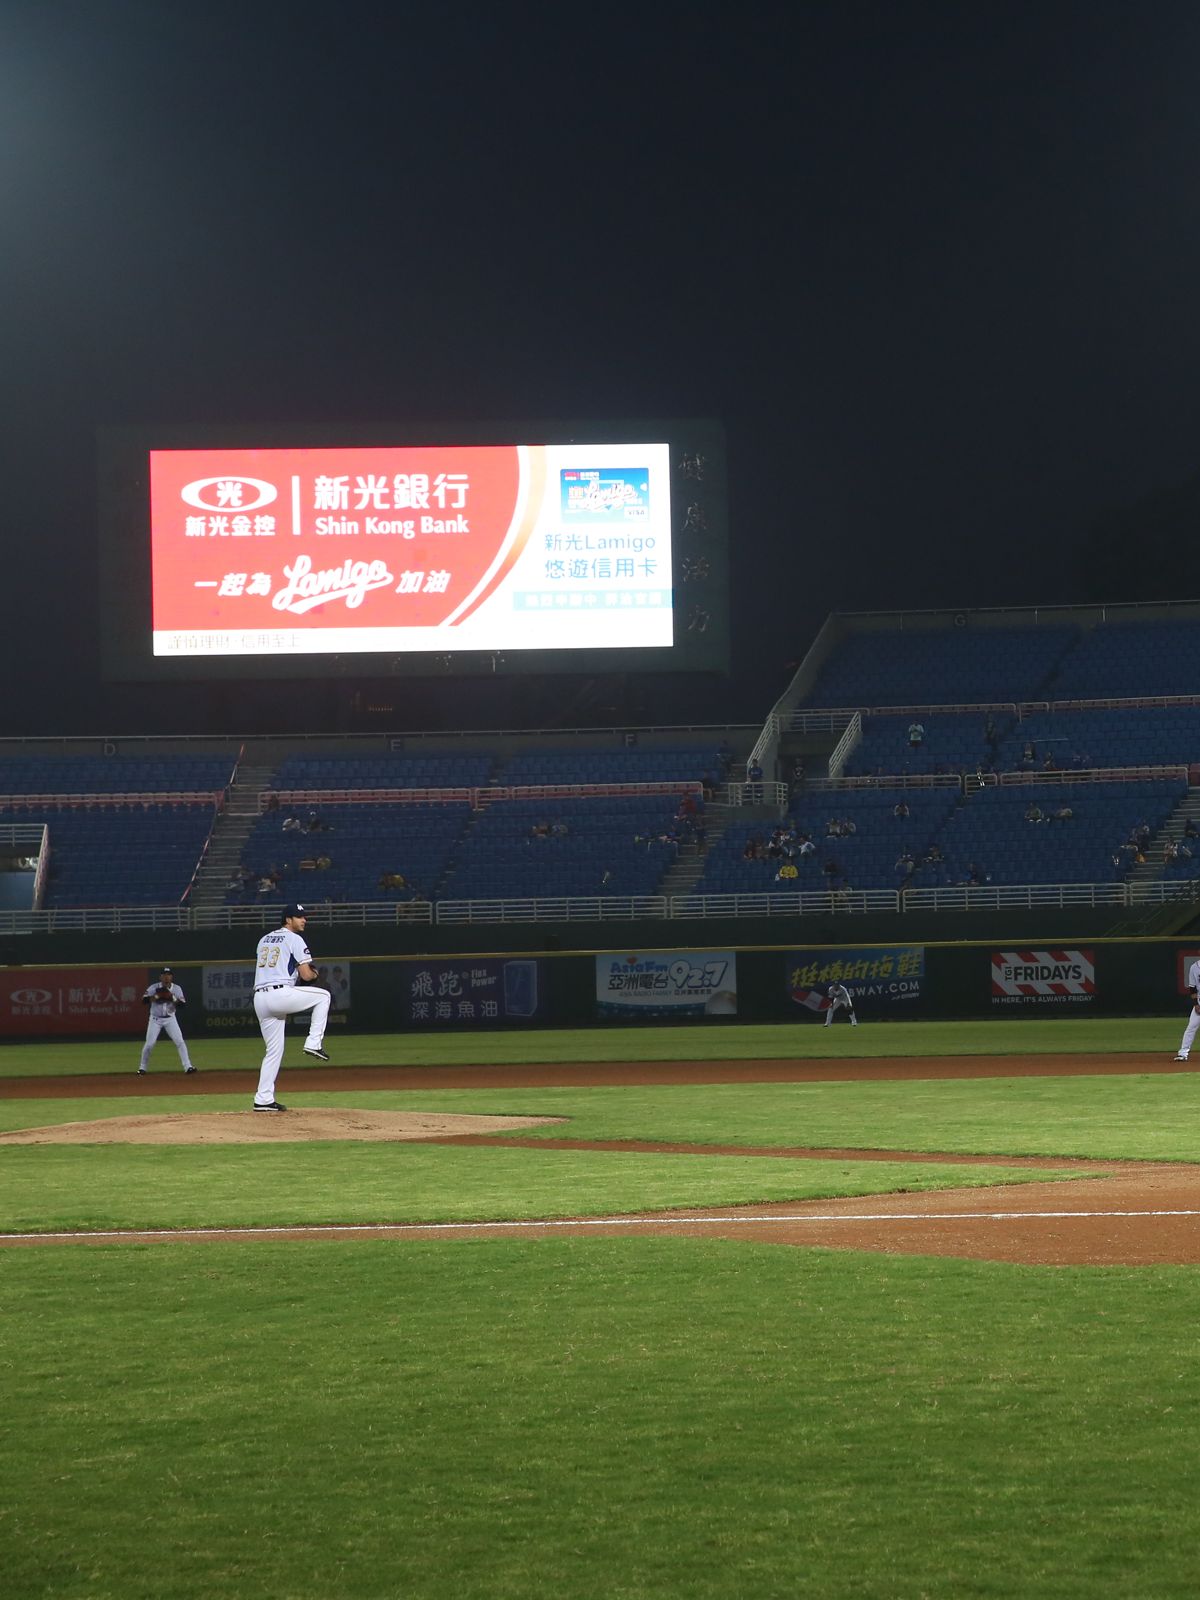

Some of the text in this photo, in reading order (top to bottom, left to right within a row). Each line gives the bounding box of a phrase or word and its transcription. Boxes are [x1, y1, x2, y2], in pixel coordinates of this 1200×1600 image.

[216, 481, 243, 507] 光
[314, 473, 470, 511] 新光銀行
[185, 514, 276, 537] 新光金控
[315, 515, 470, 539] Shin Kong Bank
[544, 558, 658, 580] 悠遊信用卡
[194, 554, 451, 615] 一起為 Lamigo 加油
[954, 614, 966, 627] G
[103, 743, 116, 756] D
[390, 738, 401, 752] E
[624, 733, 635, 747] F
[258, 946, 281, 968] 33
[471, 976, 497, 988] Power
[608, 973, 669, 991] 亞洲電台
[668, 957, 729, 988] 92.7
[1004, 964, 1082, 981] TGI FRIDAYS
[848, 980, 921, 998] BWAY.COM
[411, 999, 498, 1020] 深海魚油
